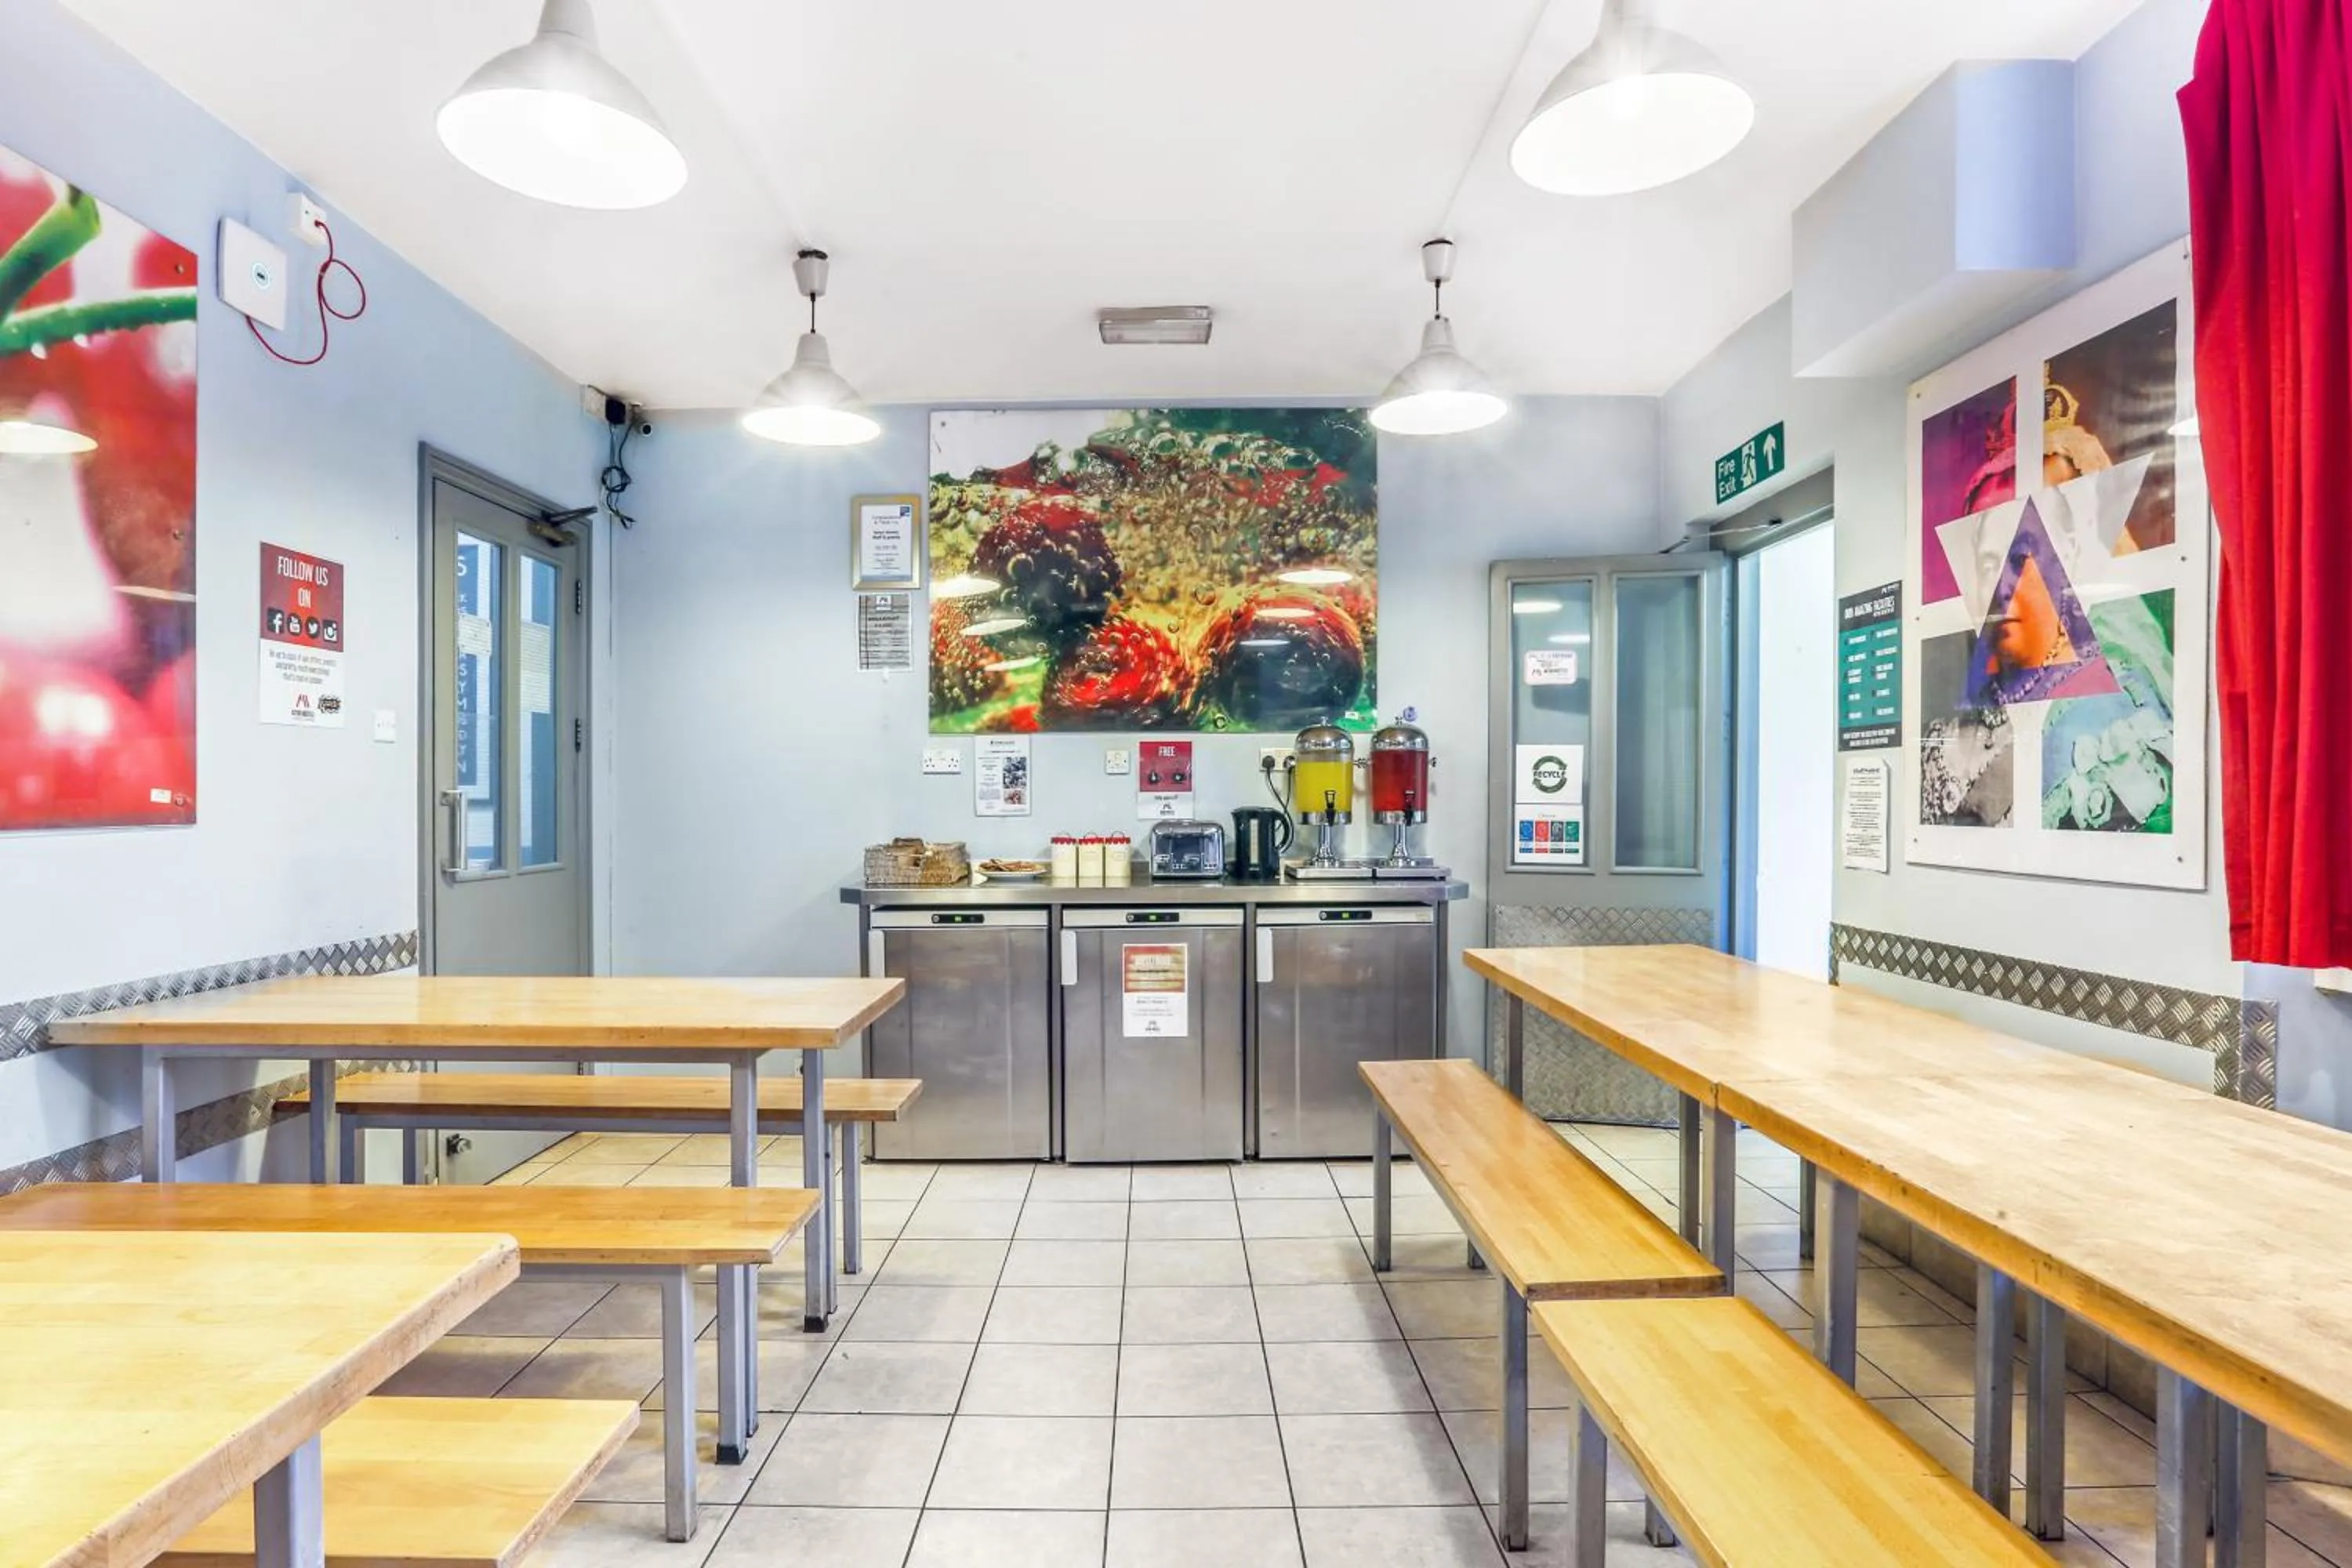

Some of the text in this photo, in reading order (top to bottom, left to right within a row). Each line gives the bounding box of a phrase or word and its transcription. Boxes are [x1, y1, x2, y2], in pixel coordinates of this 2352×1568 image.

[1718, 459, 1735, 479] Fire
[1719, 476, 1737, 499] Exit
[277, 556, 328, 586] FOLLOW US
[298, 587, 311, 609] ON
[1157, 746, 1176, 757] FREE
[1534, 771, 1566, 779] RECYCLE
